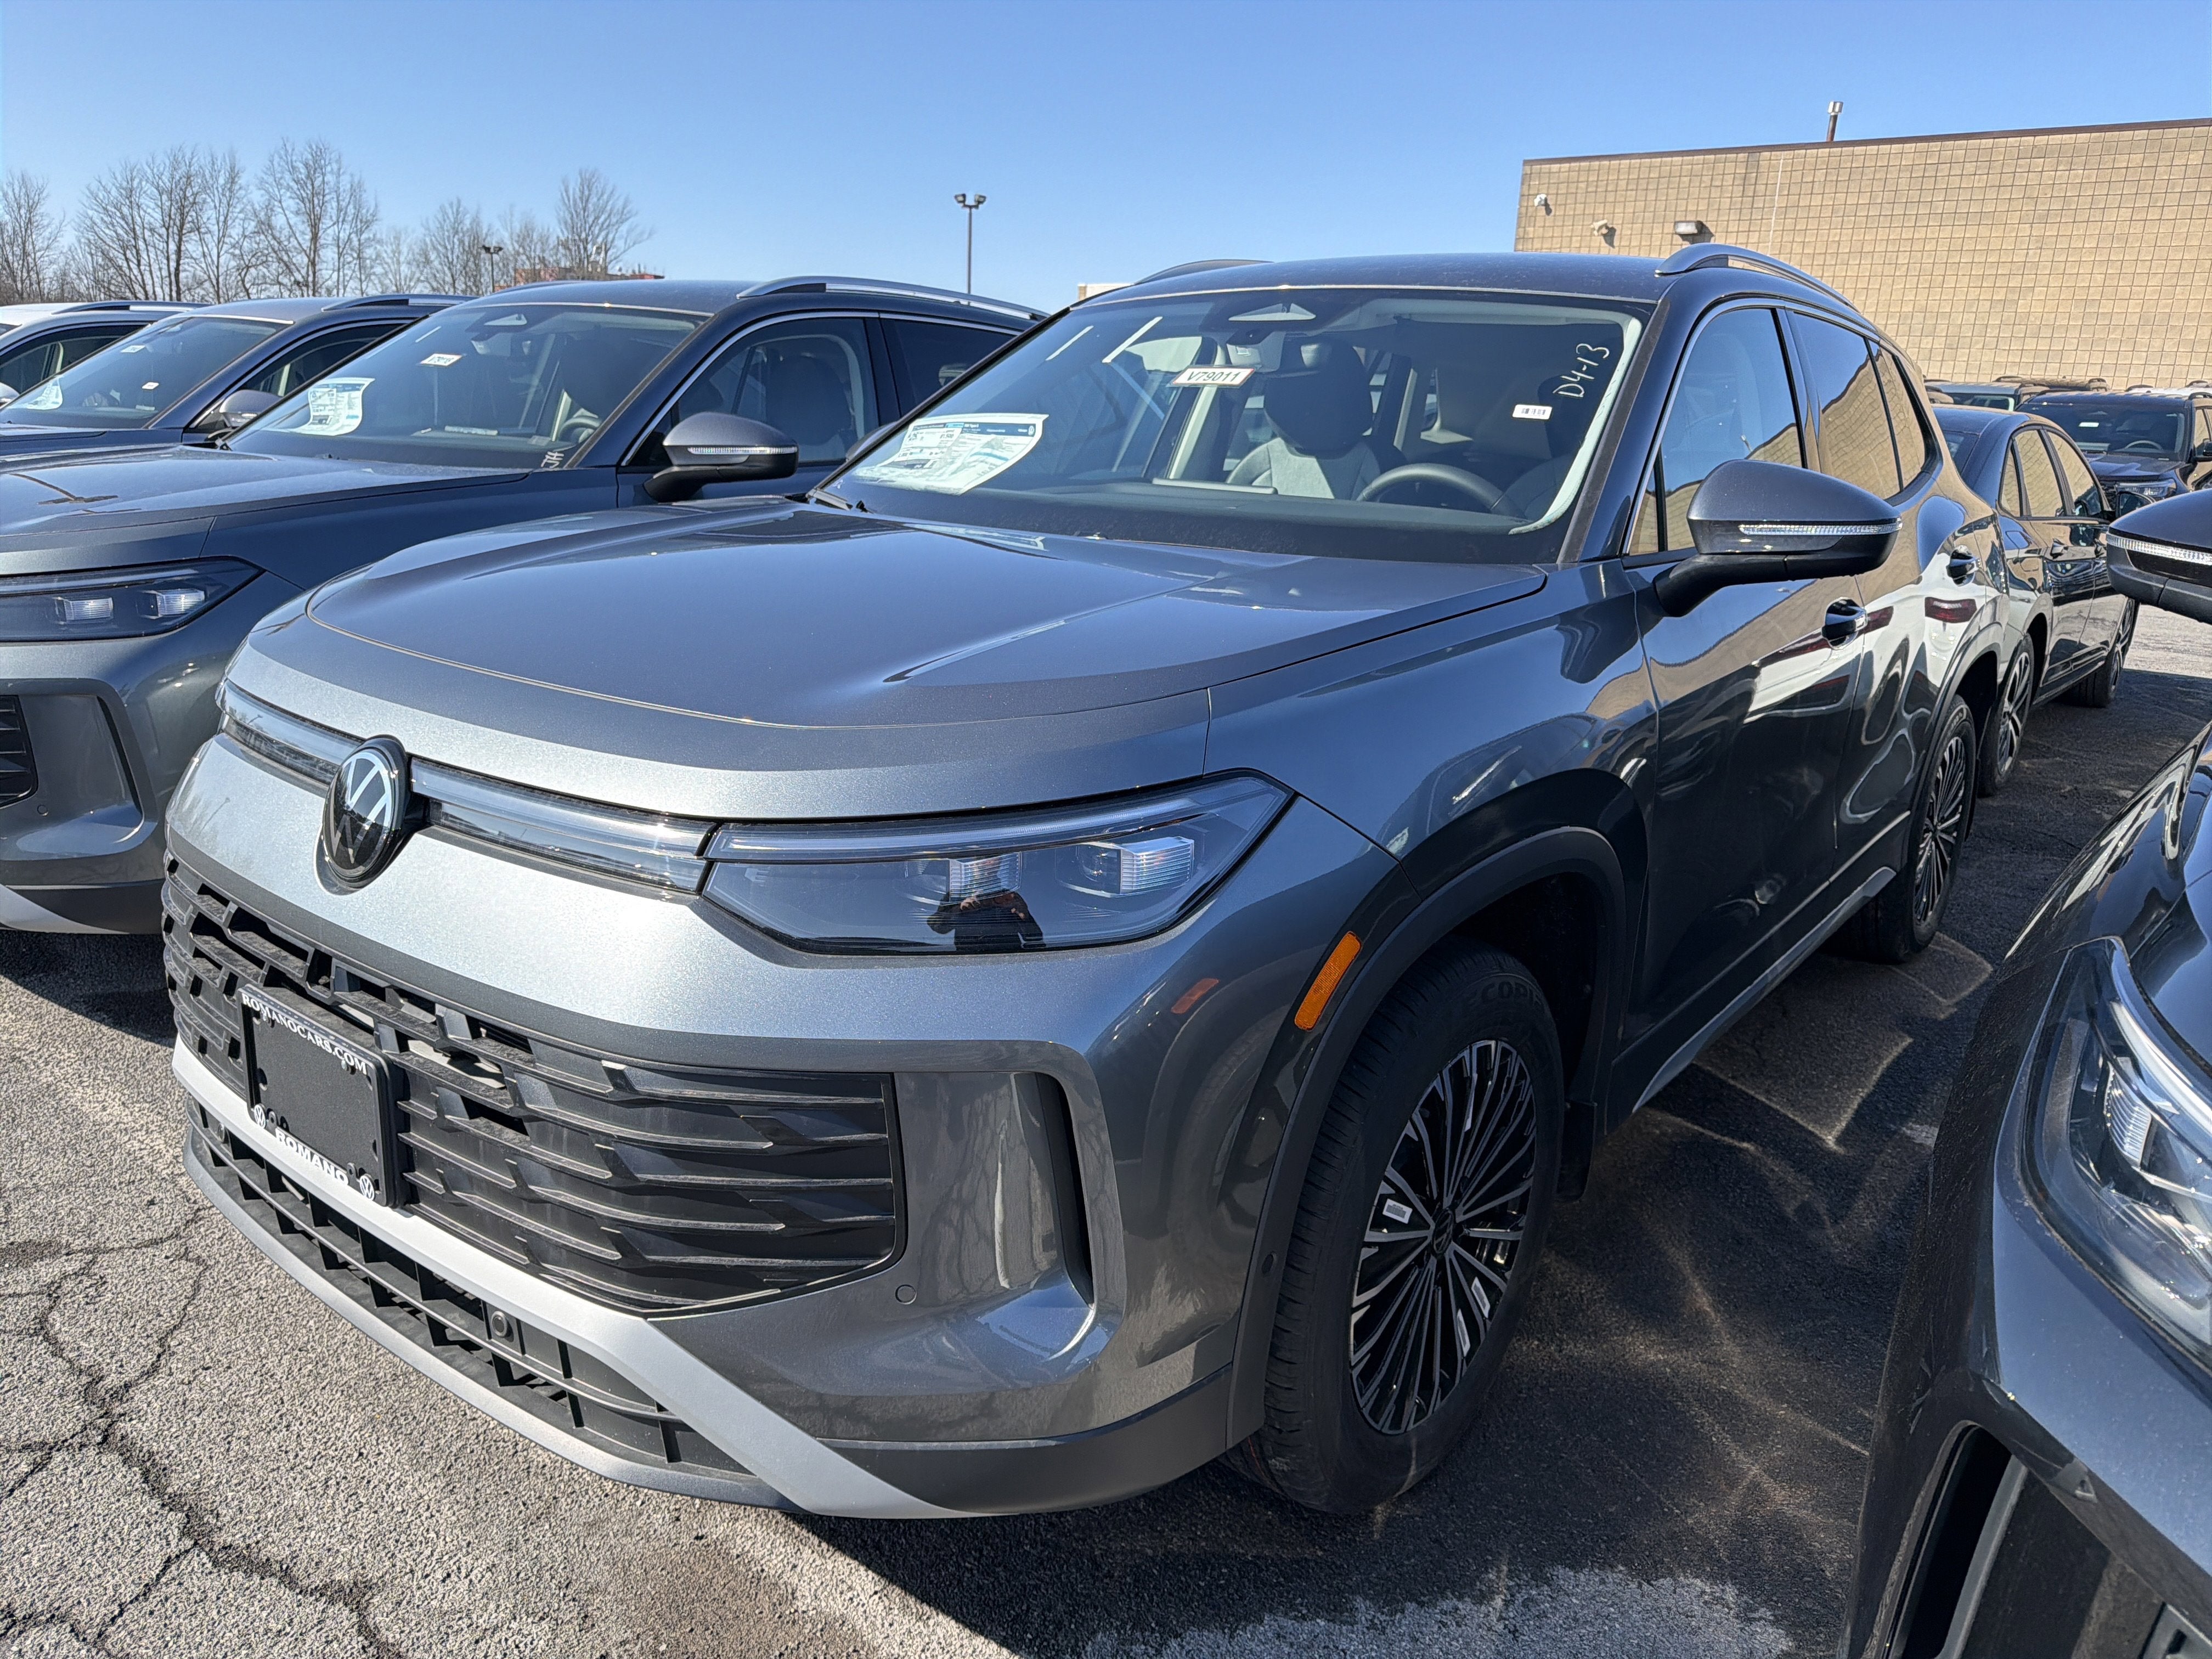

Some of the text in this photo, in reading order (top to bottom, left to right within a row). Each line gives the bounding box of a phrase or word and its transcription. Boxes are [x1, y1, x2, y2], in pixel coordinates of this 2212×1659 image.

[1187, 371, 1242, 382] V79011
[1552, 343, 1610, 398] D4-13
[241, 992, 368, 1076] ROMANOCARS.COM
[275, 1127, 349, 1186] ROMANO
